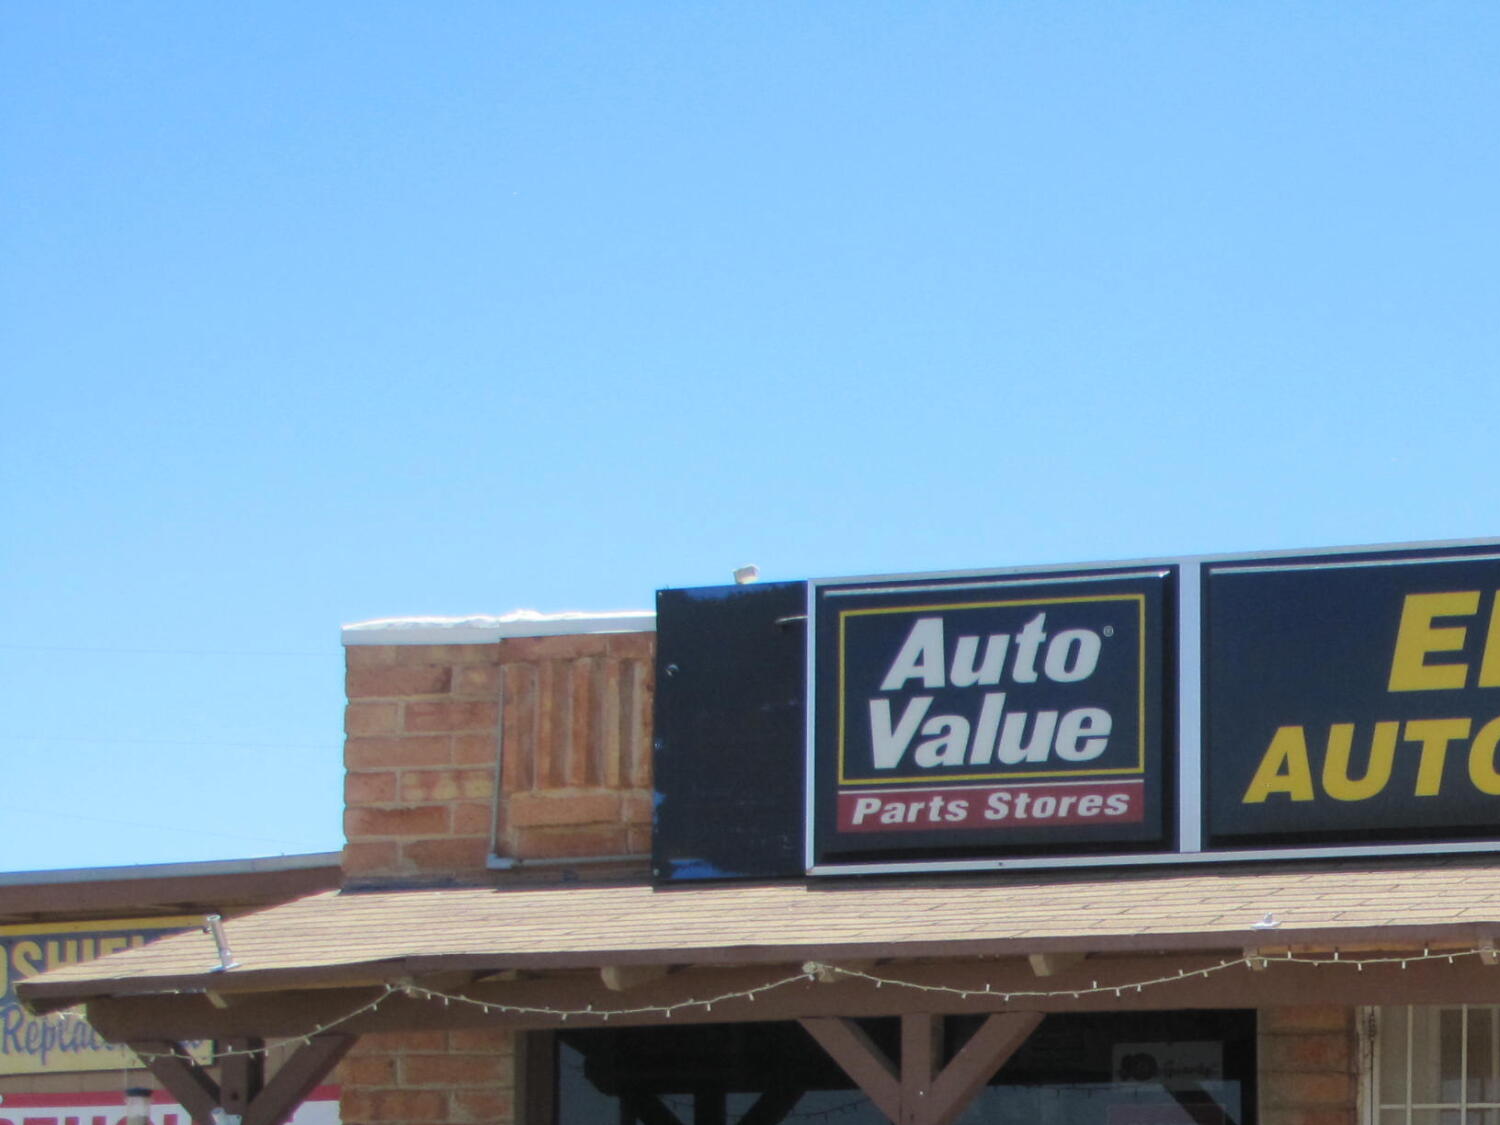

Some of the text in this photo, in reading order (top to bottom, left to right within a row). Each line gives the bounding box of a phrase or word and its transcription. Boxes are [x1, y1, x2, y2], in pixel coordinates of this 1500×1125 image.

[879, 612, 1101, 691] Auto
[869, 692, 1113, 769] Value
[851, 791, 1131, 826] Parts Stores
